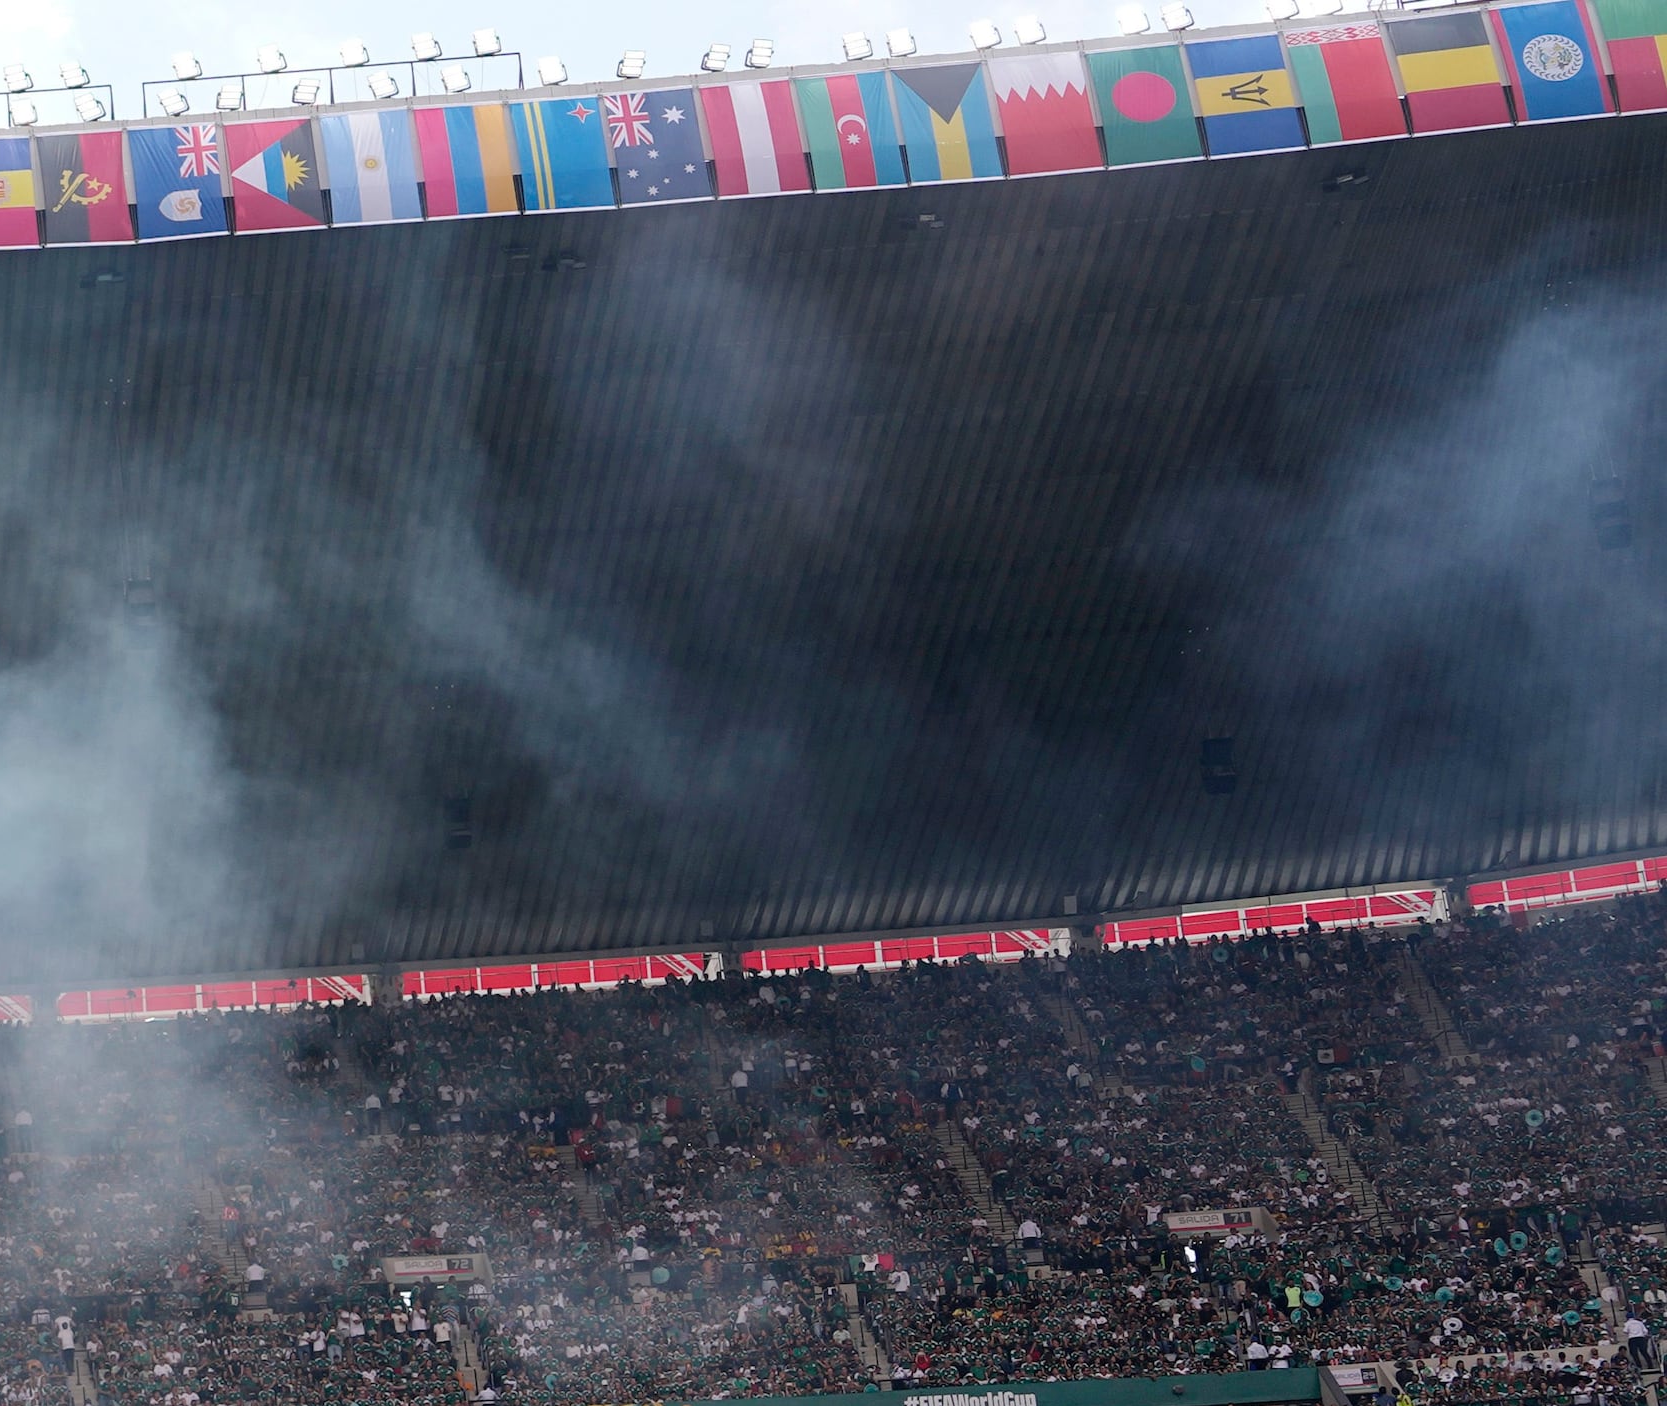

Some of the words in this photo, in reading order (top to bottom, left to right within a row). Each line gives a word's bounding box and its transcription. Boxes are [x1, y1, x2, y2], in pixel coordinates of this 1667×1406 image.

[1178, 1214, 1219, 1225] SALIDA
[1232, 1212, 1246, 1223] 71
[404, 1261, 443, 1271] SALIDA
[451, 1259, 467, 1269] 72
[1362, 1371, 1376, 1381] 29
